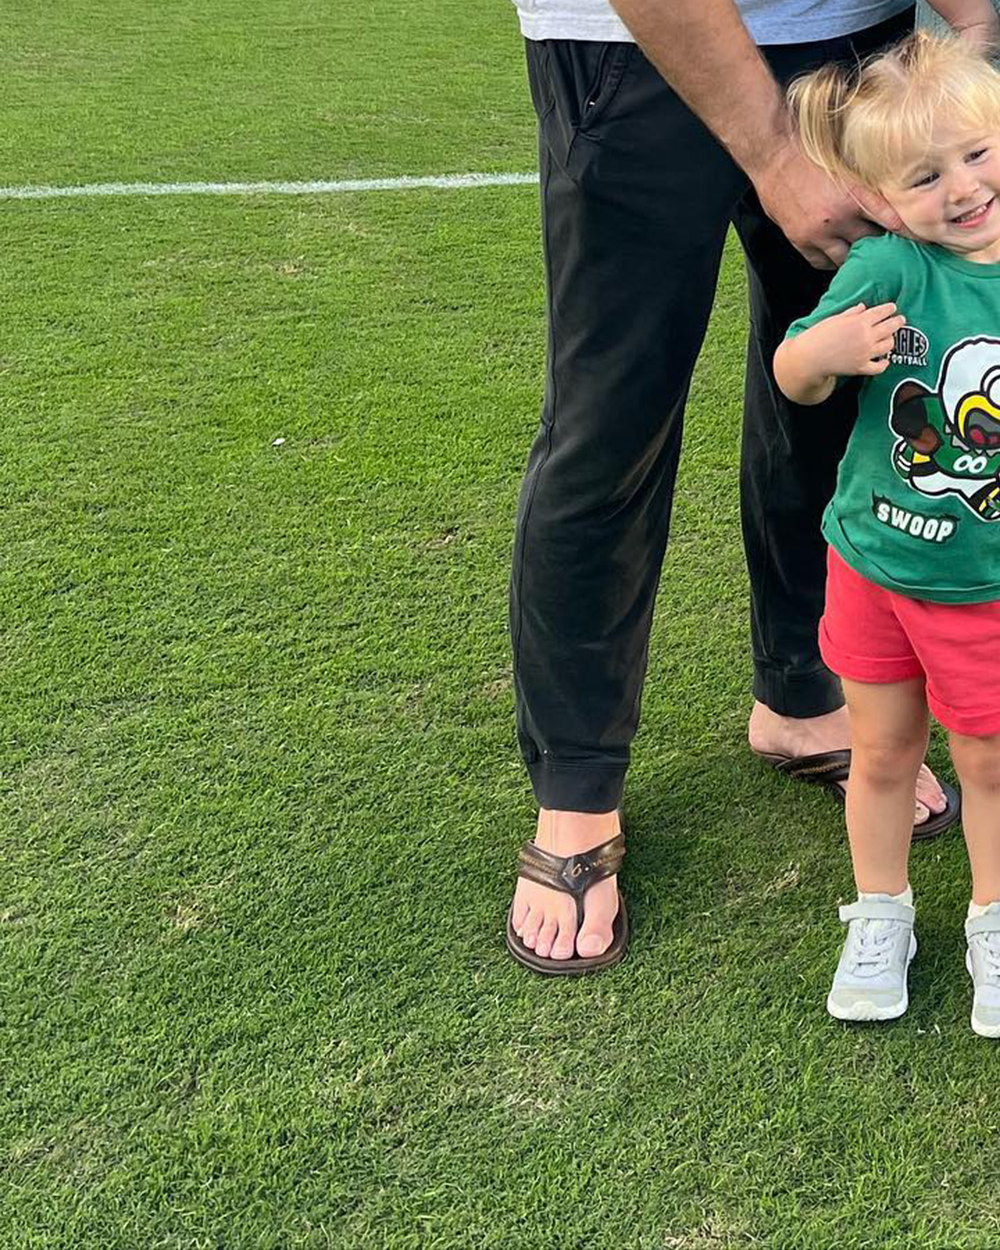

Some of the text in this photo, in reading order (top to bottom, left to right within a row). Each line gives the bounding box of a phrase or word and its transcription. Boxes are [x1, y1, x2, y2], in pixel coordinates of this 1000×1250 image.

[887, 351, 928, 367] FOOTBALL
[953, 454, 988, 474] 00
[876, 503, 955, 543] SWOOP
